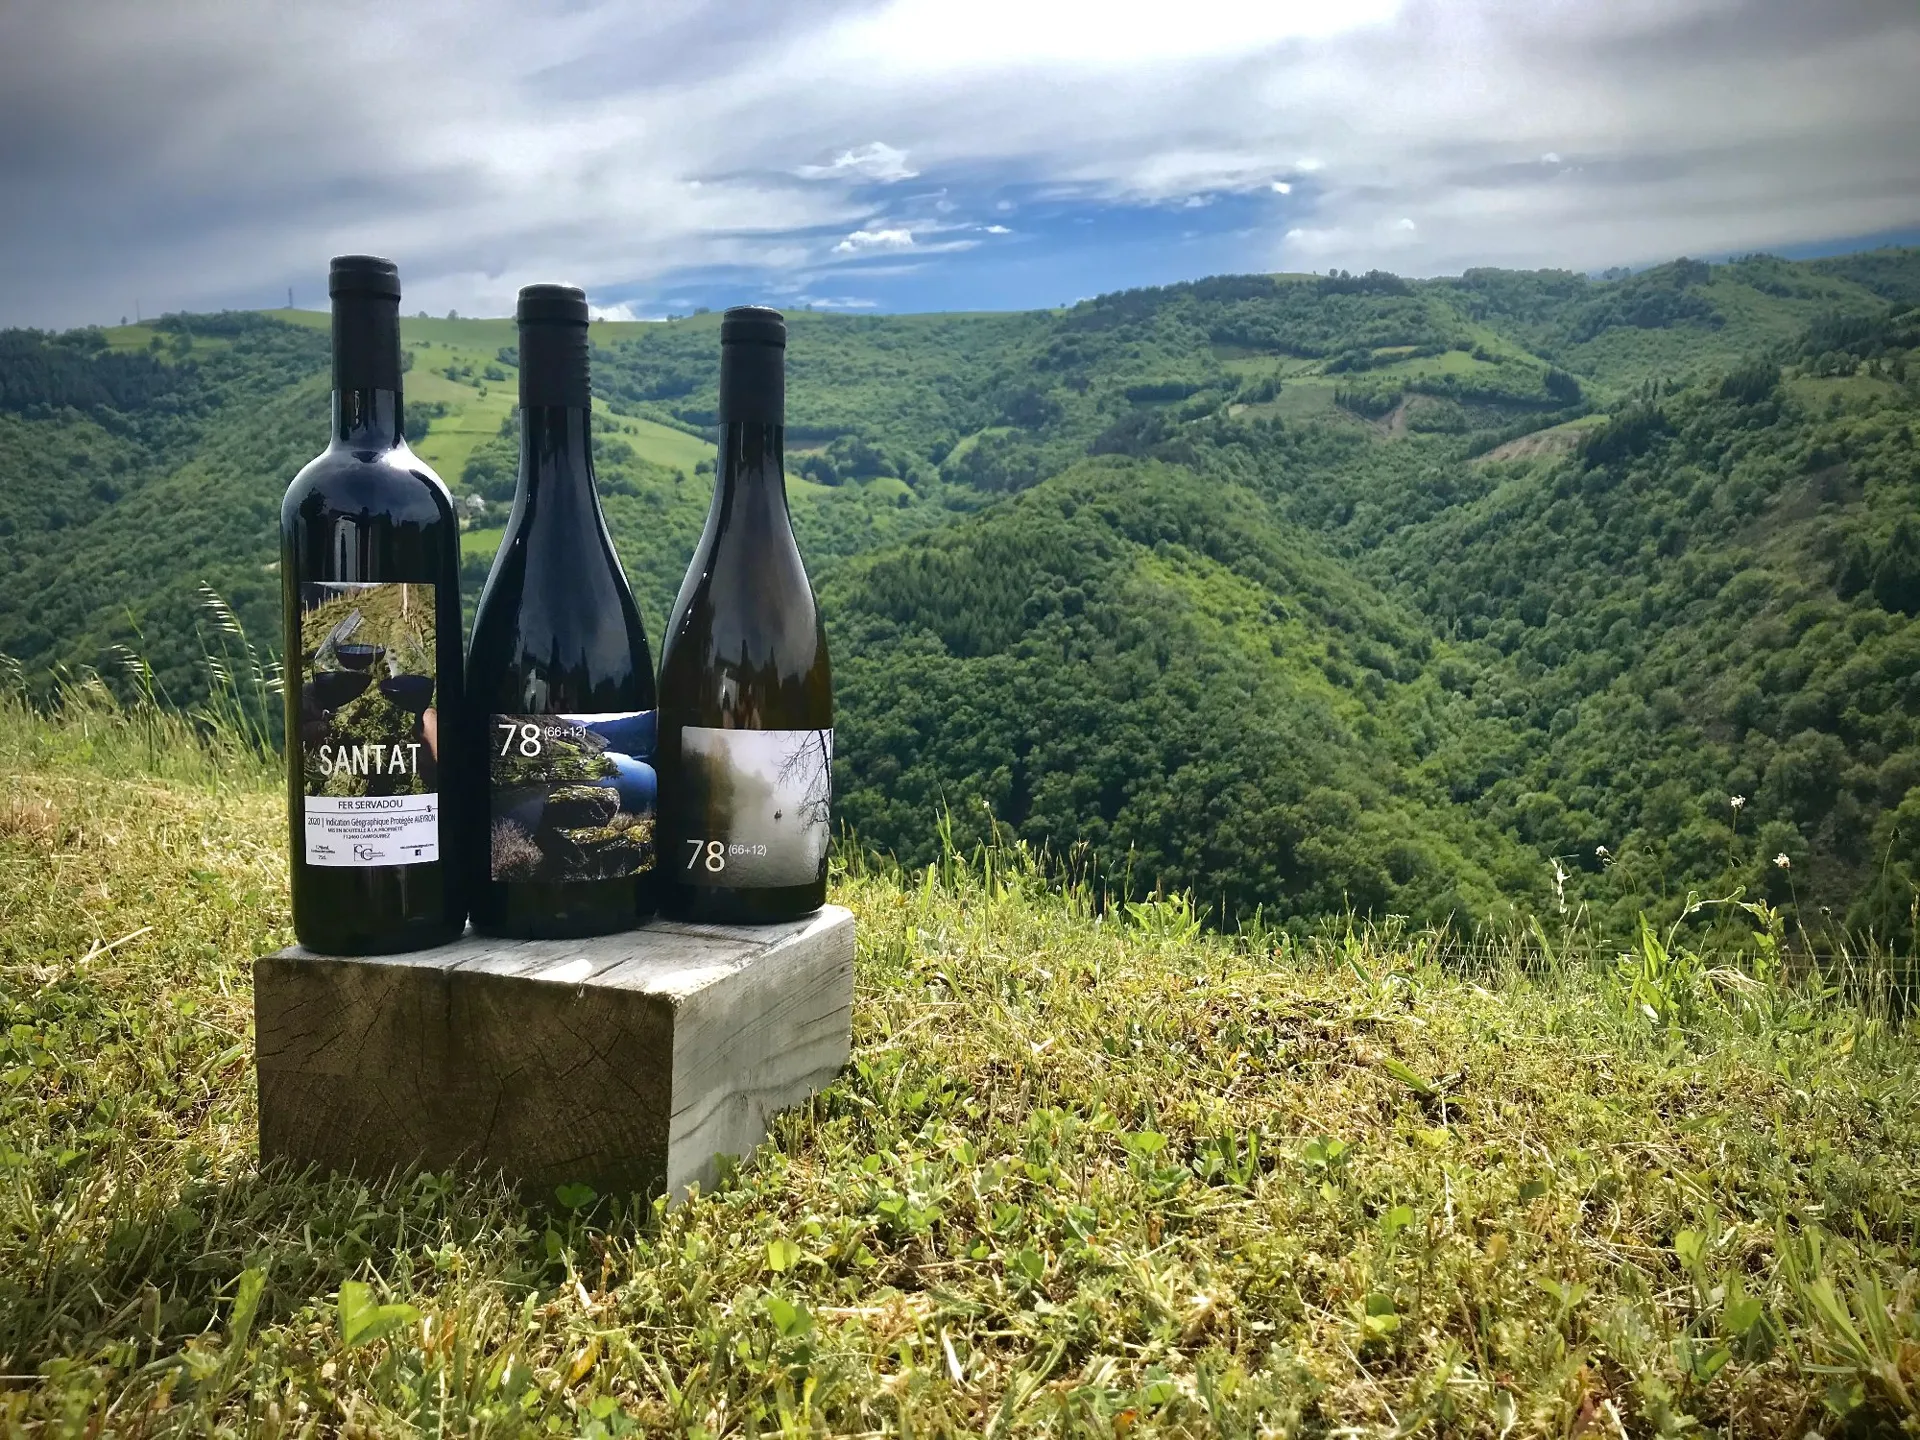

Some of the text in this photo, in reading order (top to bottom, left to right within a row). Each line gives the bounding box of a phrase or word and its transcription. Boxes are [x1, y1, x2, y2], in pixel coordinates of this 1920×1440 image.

[498, 723, 586, 757] 78 (66+12)
[320, 744, 421, 776] SANTAT
[338, 800, 403, 809] FER SERVADOU
[308, 816, 320, 826] 2020
[326, 818, 350, 826] Indication
[686, 840, 767, 872] 78 (66+12)
